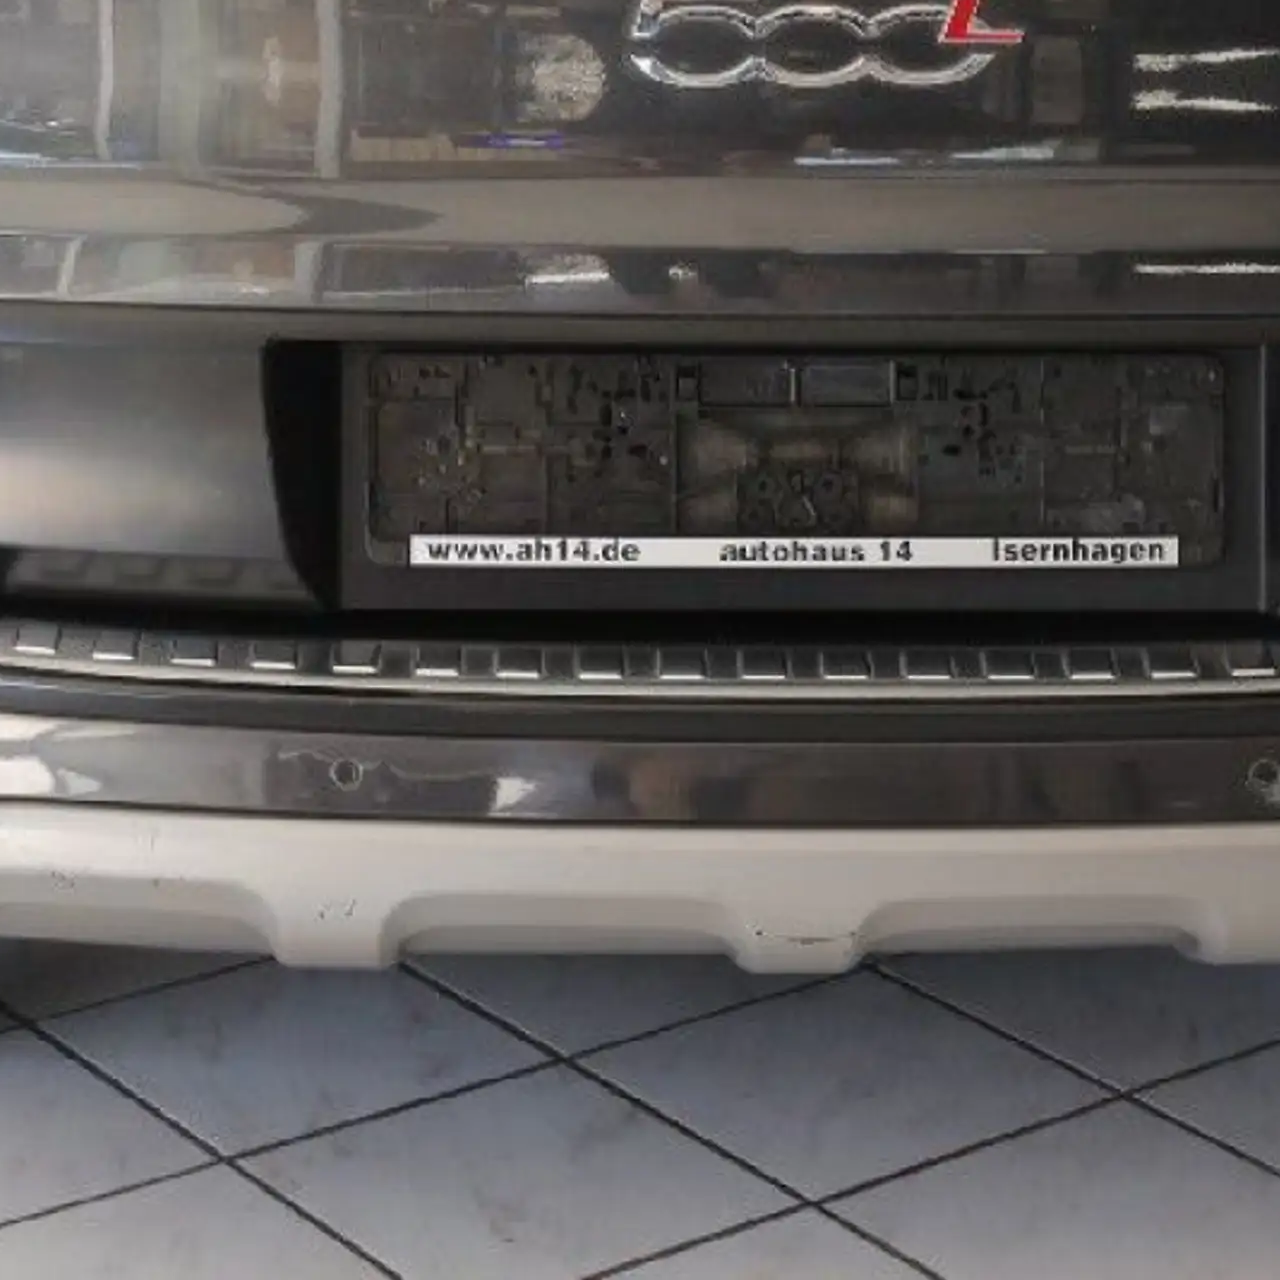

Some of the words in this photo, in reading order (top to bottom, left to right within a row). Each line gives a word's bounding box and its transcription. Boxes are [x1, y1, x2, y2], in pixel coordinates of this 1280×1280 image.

[426, 539, 641, 563] www.ah14.de
[718, 540, 866, 563] autohaus
[880, 539, 913, 563] 14
[992, 538, 1166, 565] Isernhagen
